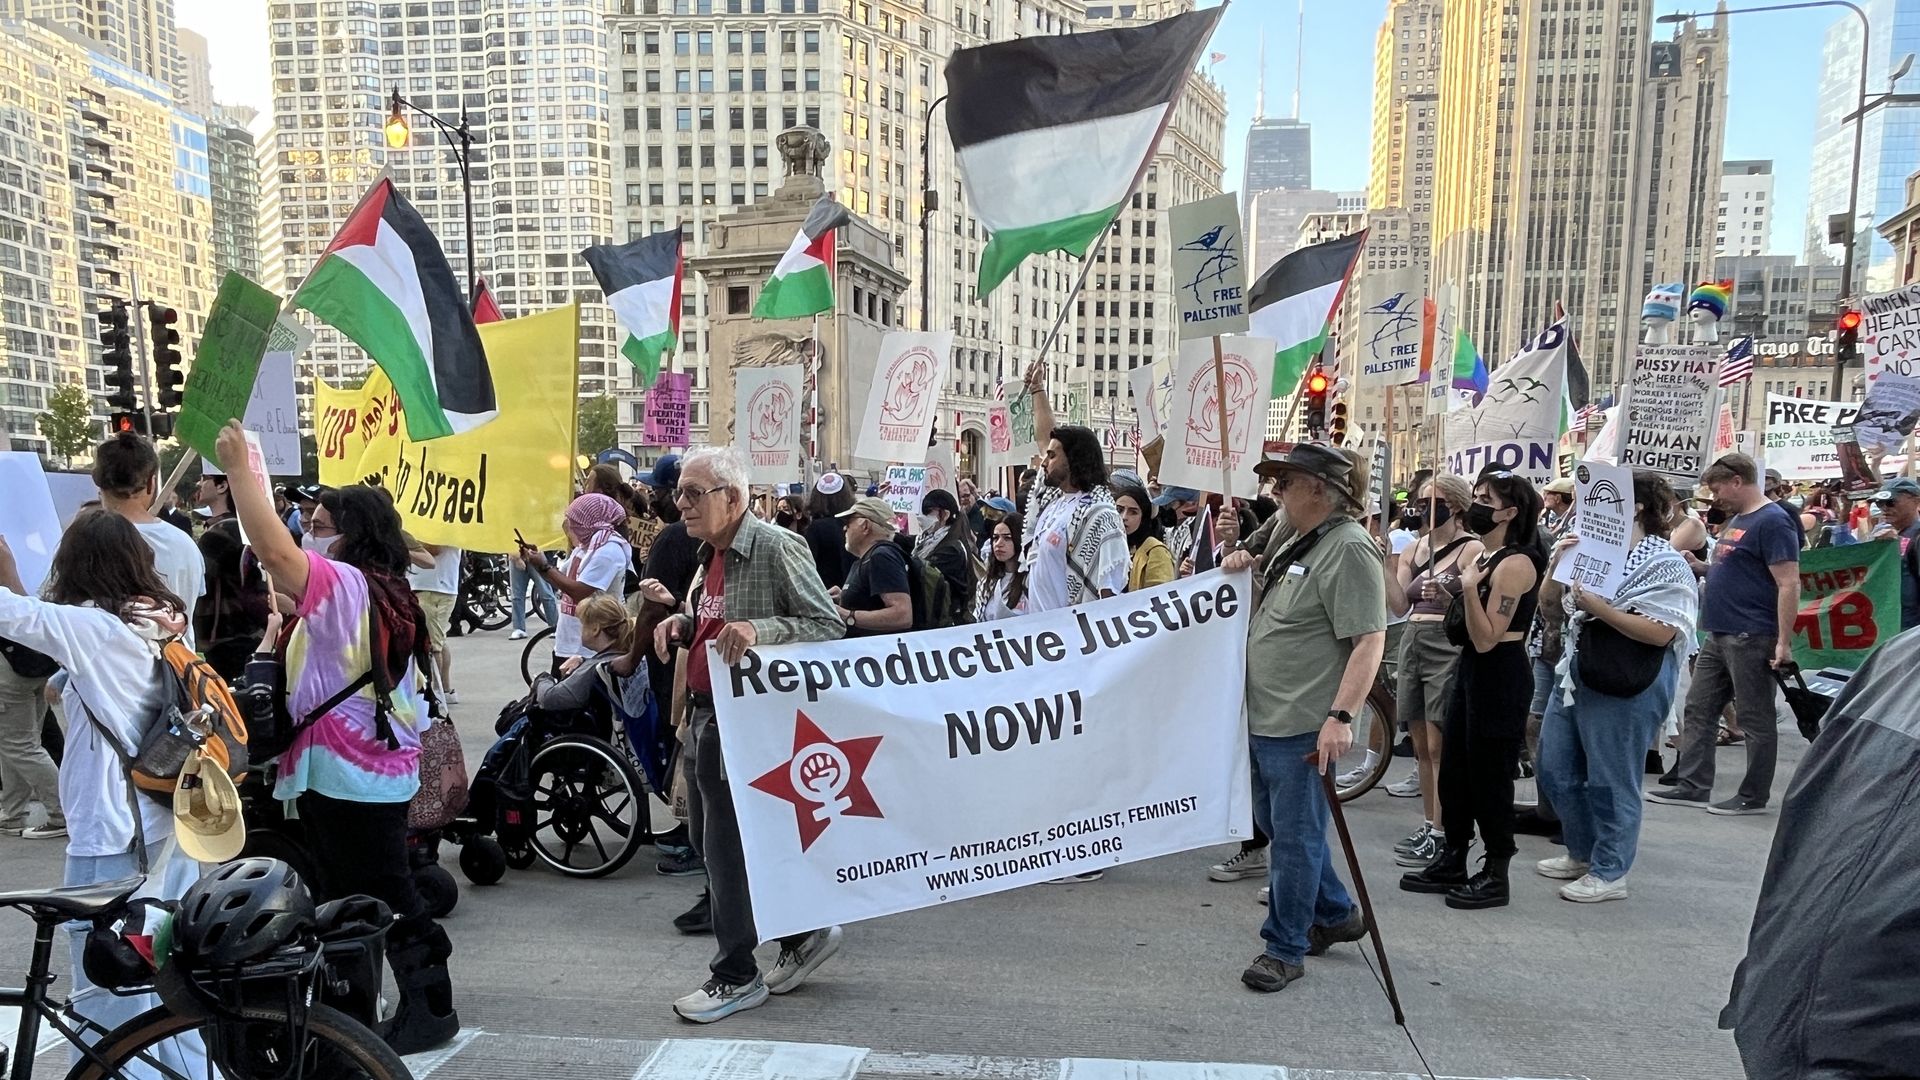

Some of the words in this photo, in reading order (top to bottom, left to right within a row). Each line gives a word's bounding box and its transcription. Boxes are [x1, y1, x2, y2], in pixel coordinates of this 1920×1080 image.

[1213, 286, 1242, 302] FREE
[1183, 303, 1244, 323] PALESTINE
[1391, 343, 1418, 357] FREE
[1877, 329, 1920, 356] CAR
[1364, 357, 1416, 375] PALESTINE
[1635, 359, 1679, 372] PUSSY
[1683, 360, 1716, 374] HAT
[1656, 373, 1686, 384] HERE!
[1674, 391, 1702, 400] RIGHTS
[1675, 400, 1704, 408] RIGHTS
[1660, 414, 1687, 423] RIGHTS
[1674, 408, 1702, 417] RIGHTS
[1769, 401, 1831, 425] FREE
[665, 426, 685, 435] FREE
[681, 419, 685, 427] A
[1667, 425, 1694, 433] RIGHTS
[1627, 428, 1702, 452] HUMAN
[1767, 432, 1790, 441] END
[1795, 430, 1816, 439] ALL
[1767, 440, 1786, 448] AID
[1791, 440, 1805, 448] TO
[1622, 448, 1700, 472] RIGHTS!
[889, 468, 906, 479] FUCK
[411, 446, 487, 524] Israel
[730, 629, 1066, 702] Reproductive
[1075, 583, 1239, 655] Justice
[945, 690, 1083, 758] NOW!
[836, 851, 928, 883] SOLIDARITY
[950, 831, 1043, 861] ANTIRACIST,
[1047, 812, 1125, 841] SOCIALIST,
[1128, 796, 1197, 823] FEMINIST
[926, 837, 1123, 891] WWW.SOLIDARITY-US.ORG
